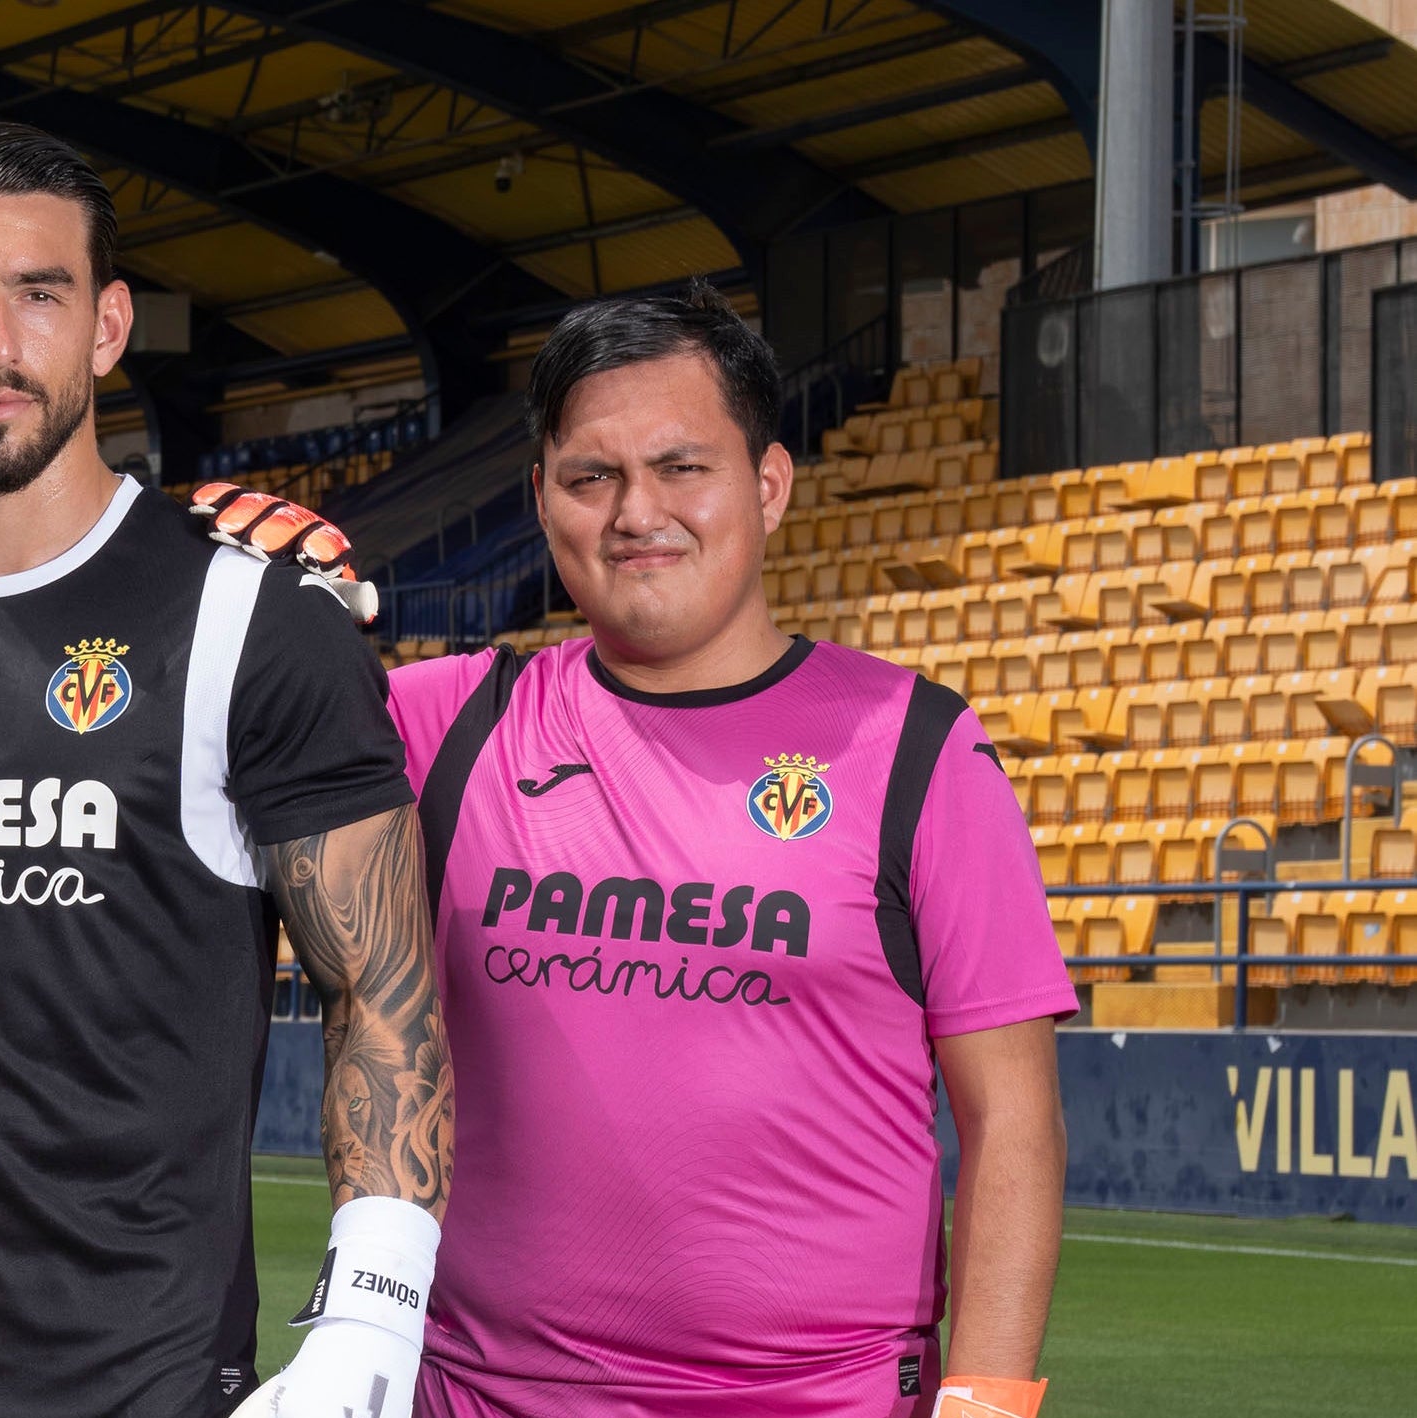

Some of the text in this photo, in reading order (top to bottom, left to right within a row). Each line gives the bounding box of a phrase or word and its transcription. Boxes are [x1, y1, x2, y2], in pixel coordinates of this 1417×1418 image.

[482, 867, 811, 958] PAMESA
[484, 946, 791, 1006] cerámica
[1227, 1065, 1417, 1180] VILLA
[351, 1269, 420, 1309] GÓMEZ
